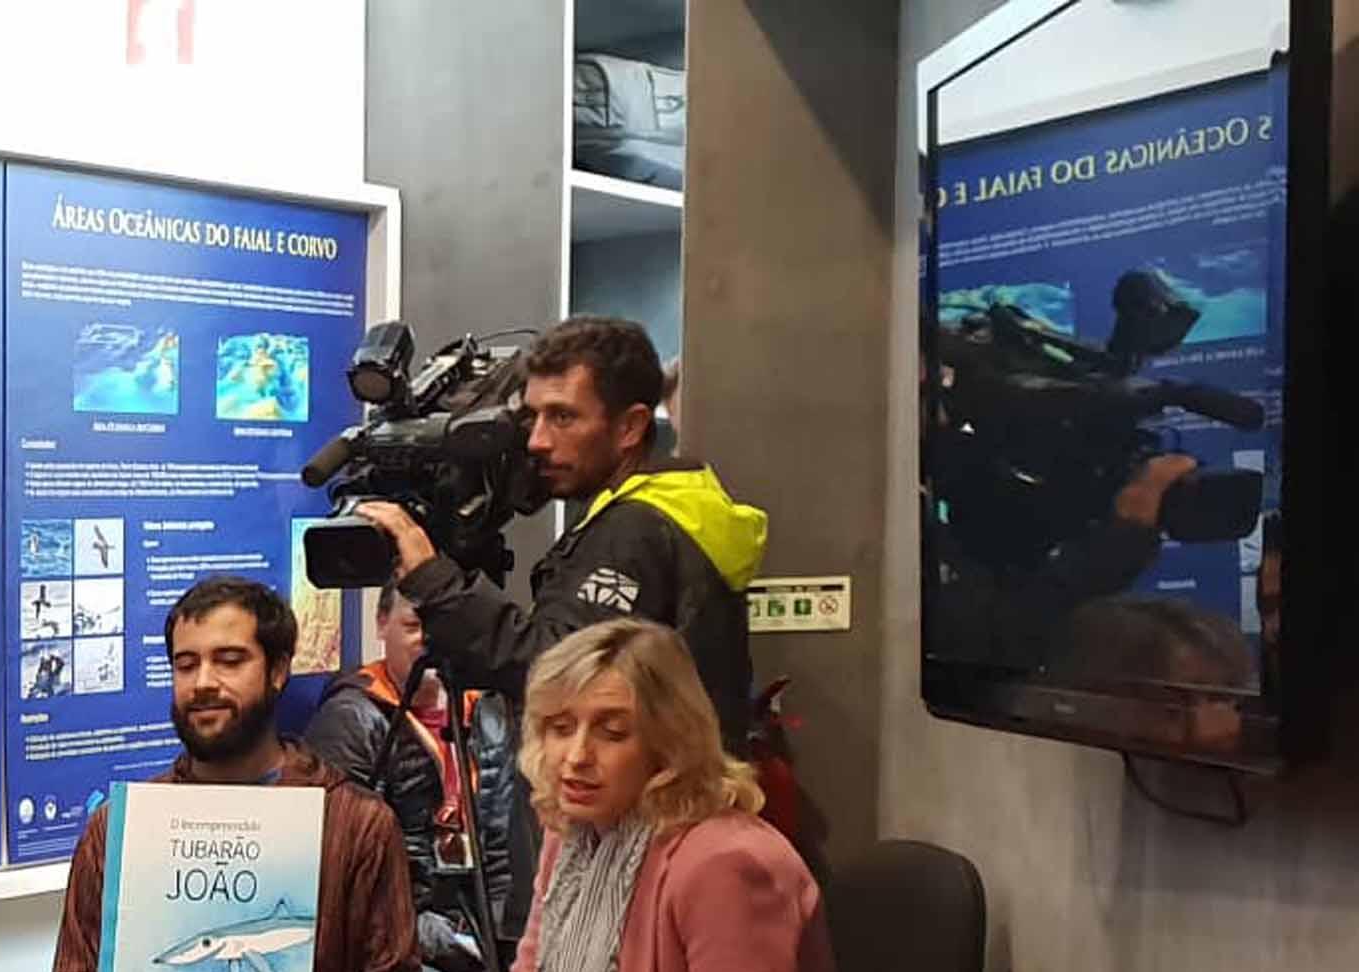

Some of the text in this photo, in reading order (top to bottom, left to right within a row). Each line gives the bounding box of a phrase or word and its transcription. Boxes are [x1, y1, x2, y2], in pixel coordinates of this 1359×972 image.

[52, 194, 338, 261] ÁREAS OCEÂNICAS DO FAIAL E CORVO
[169, 835, 260, 862] TUBARÃO
[166, 861, 257, 903] JOÃO
